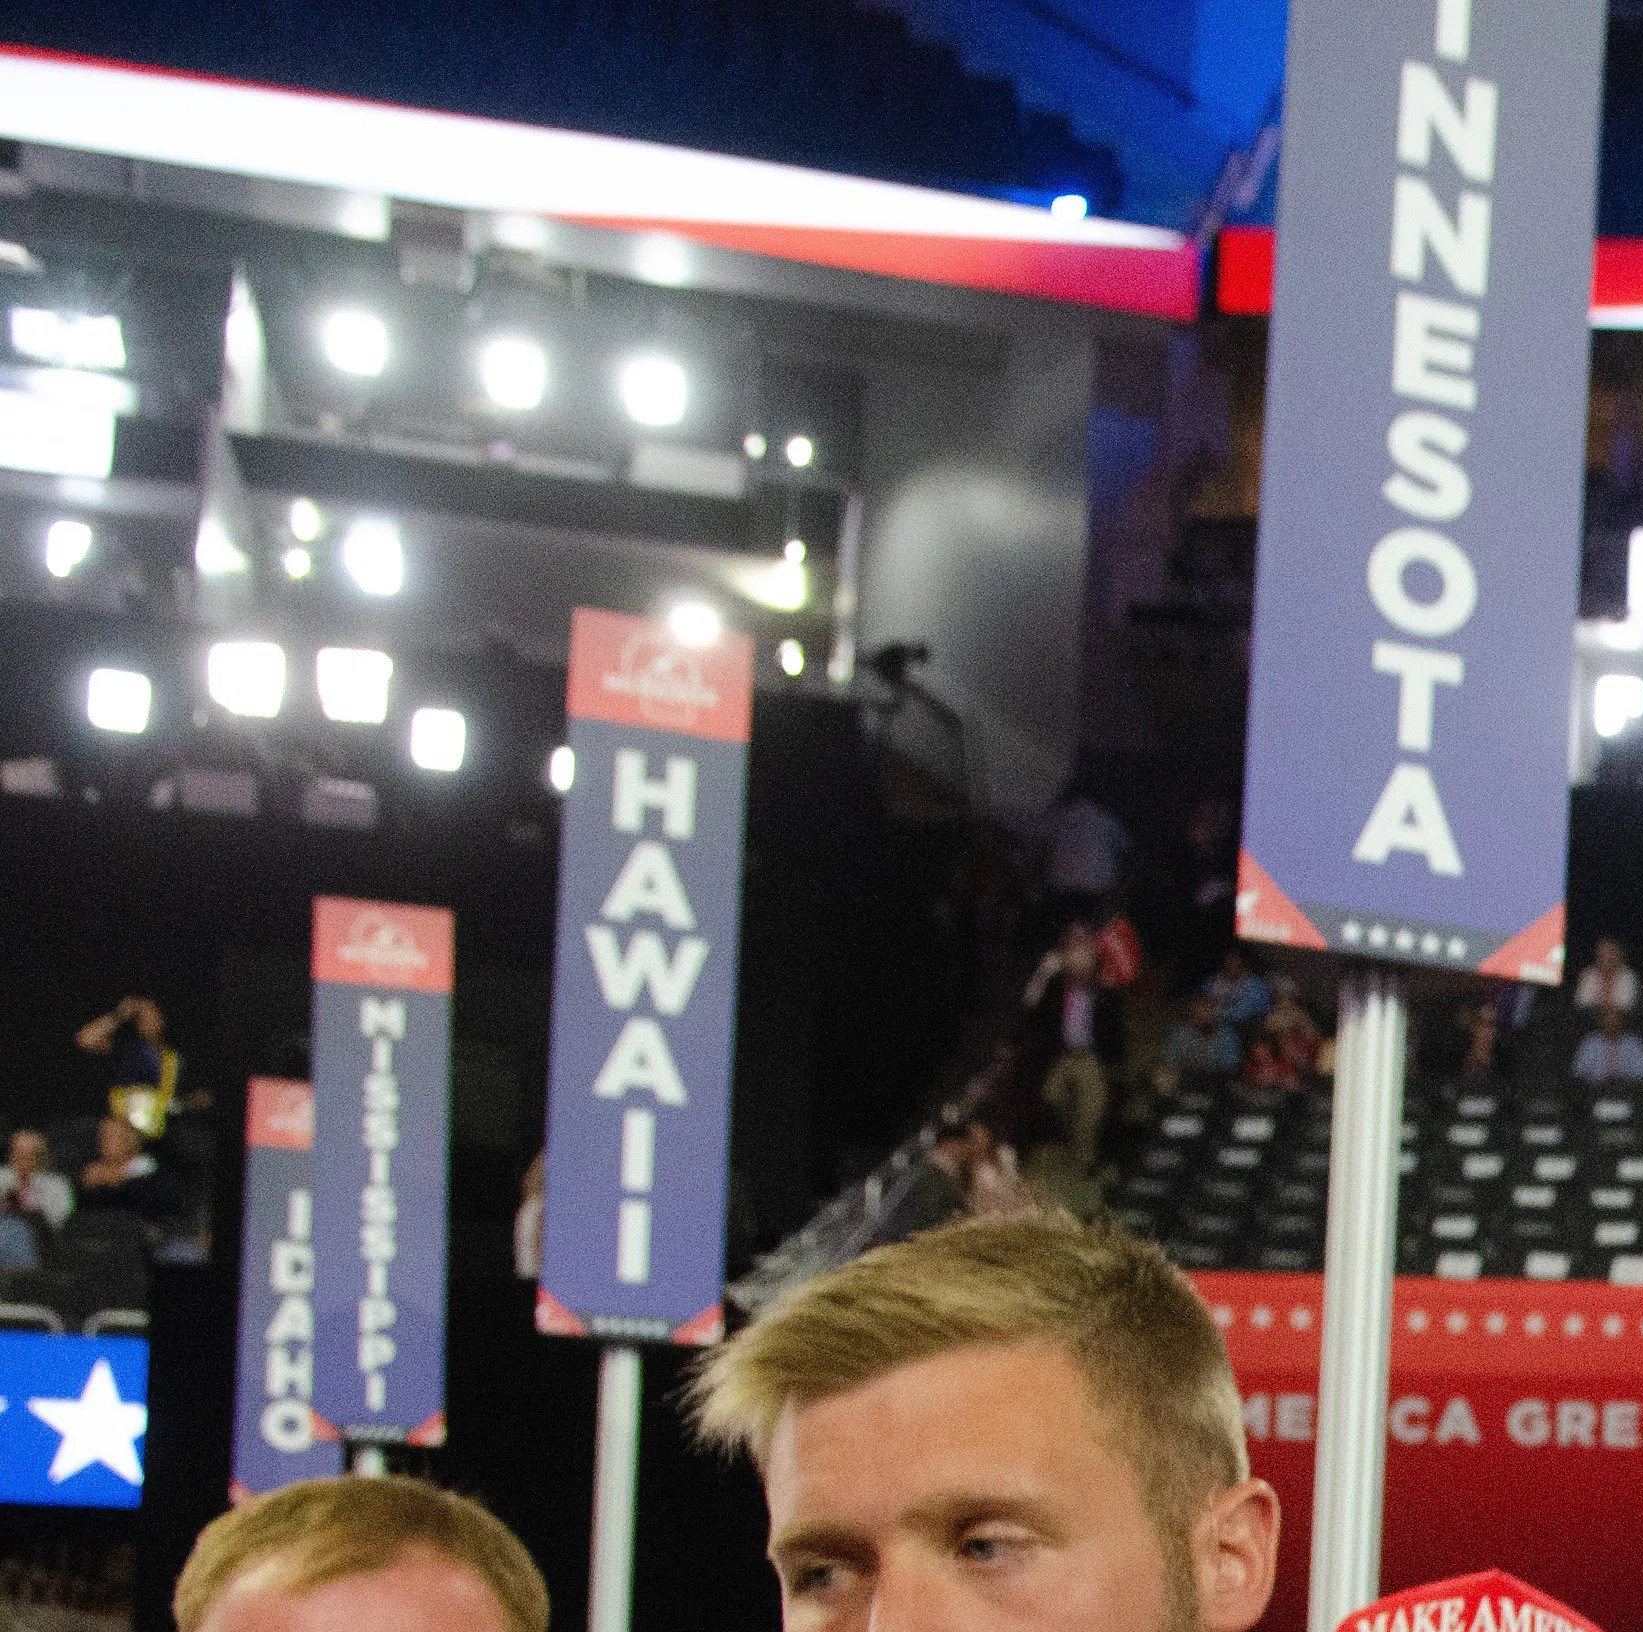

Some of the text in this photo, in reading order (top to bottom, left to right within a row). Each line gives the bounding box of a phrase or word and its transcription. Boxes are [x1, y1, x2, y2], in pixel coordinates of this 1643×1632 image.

[356, 997, 407, 1411] MISSISSIPPI
[585, 747, 709, 1285] HAWAII
[260, 1188, 315, 1453] IDAHO
